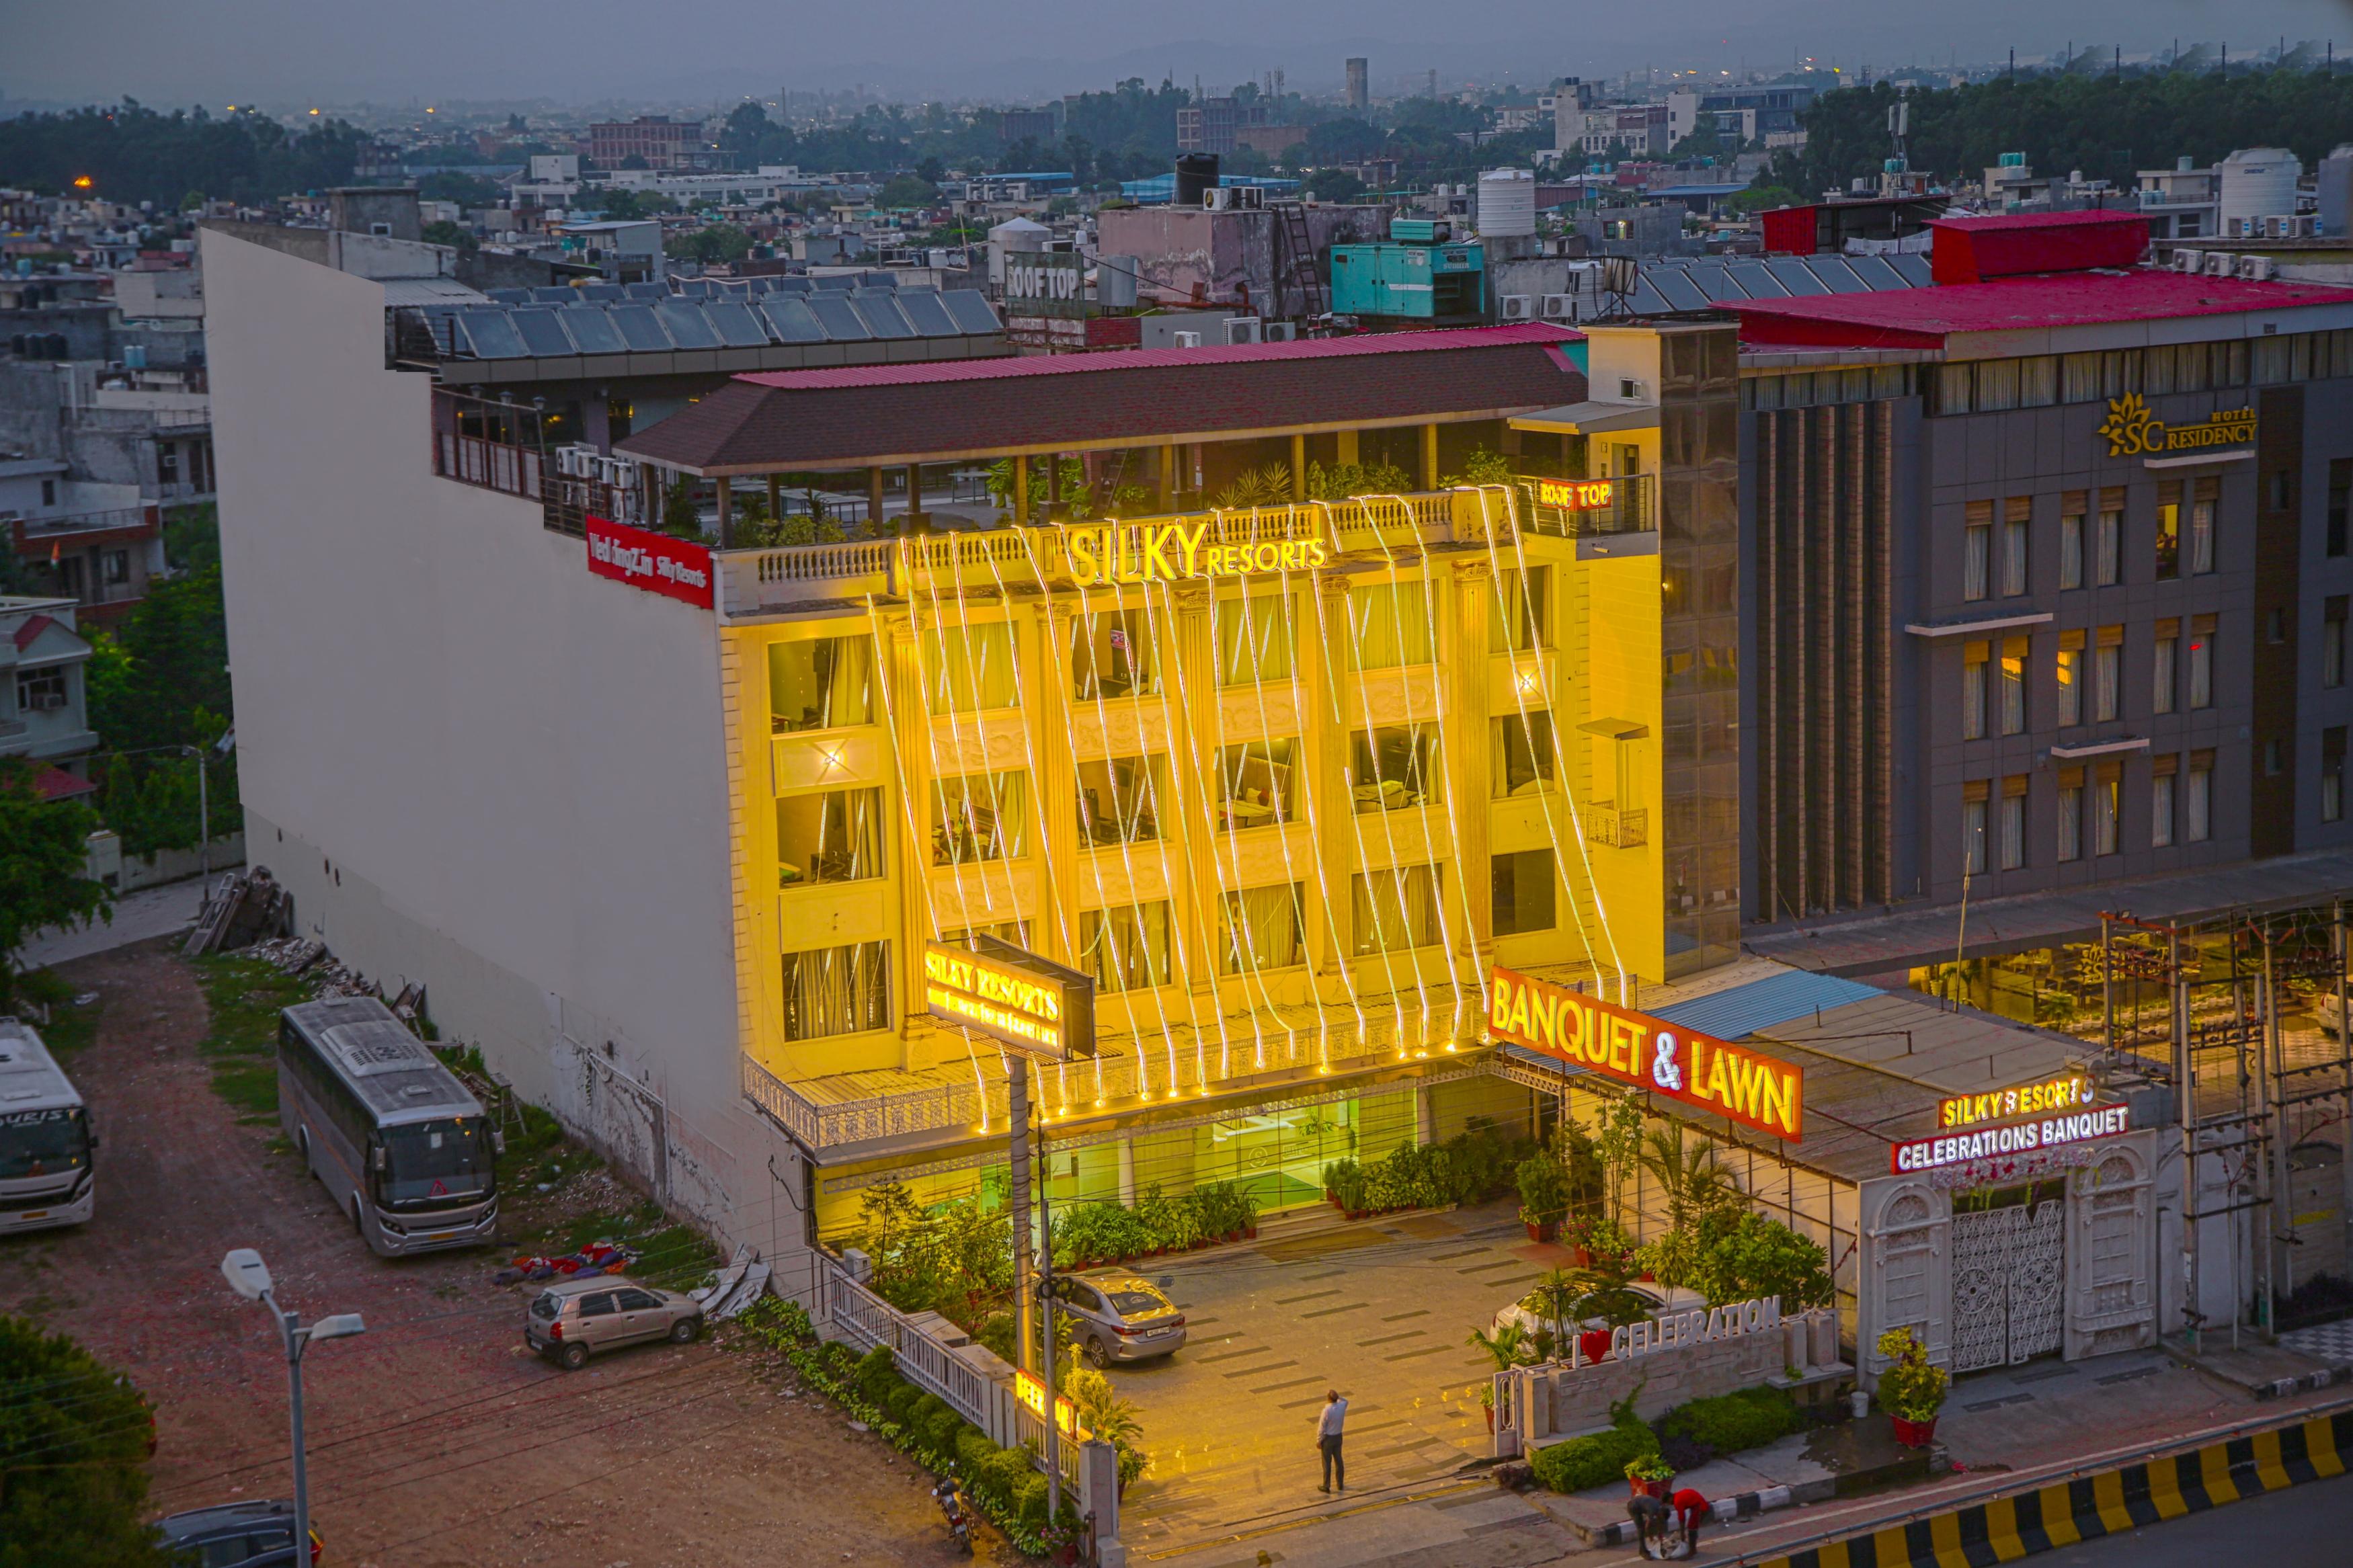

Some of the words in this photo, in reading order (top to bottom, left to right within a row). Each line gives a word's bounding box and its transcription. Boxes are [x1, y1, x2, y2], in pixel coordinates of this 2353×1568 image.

[2167, 423, 2258, 450] RESIDENCY
[2212, 408, 2257, 423] HOTEL
[1540, 483, 1573, 507] ROOF
[1577, 483, 1611, 507] TOP
[1069, 523, 1209, 587] SILKY
[1207, 538, 1327, 576] RESORTS
[925, 951, 975, 993] SILKY
[977, 967, 1058, 1022] RESORTS
[1492, 976, 1648, 1077] BANQUET
[1652, 1031, 1681, 1091] &
[1690, 1040, 1794, 1134] LAWN
[1943, 1091, 2003, 1128] SILKY
[2005, 1077, 2095, 1116] RESORTS
[1898, 1122, 2038, 1171] CELEBRATIONS
[2041, 1105, 2128, 1145] BANQUET
[1572, 1335, 1581, 1369] I
[1611, 1294, 1781, 1360] CELEBRATION
